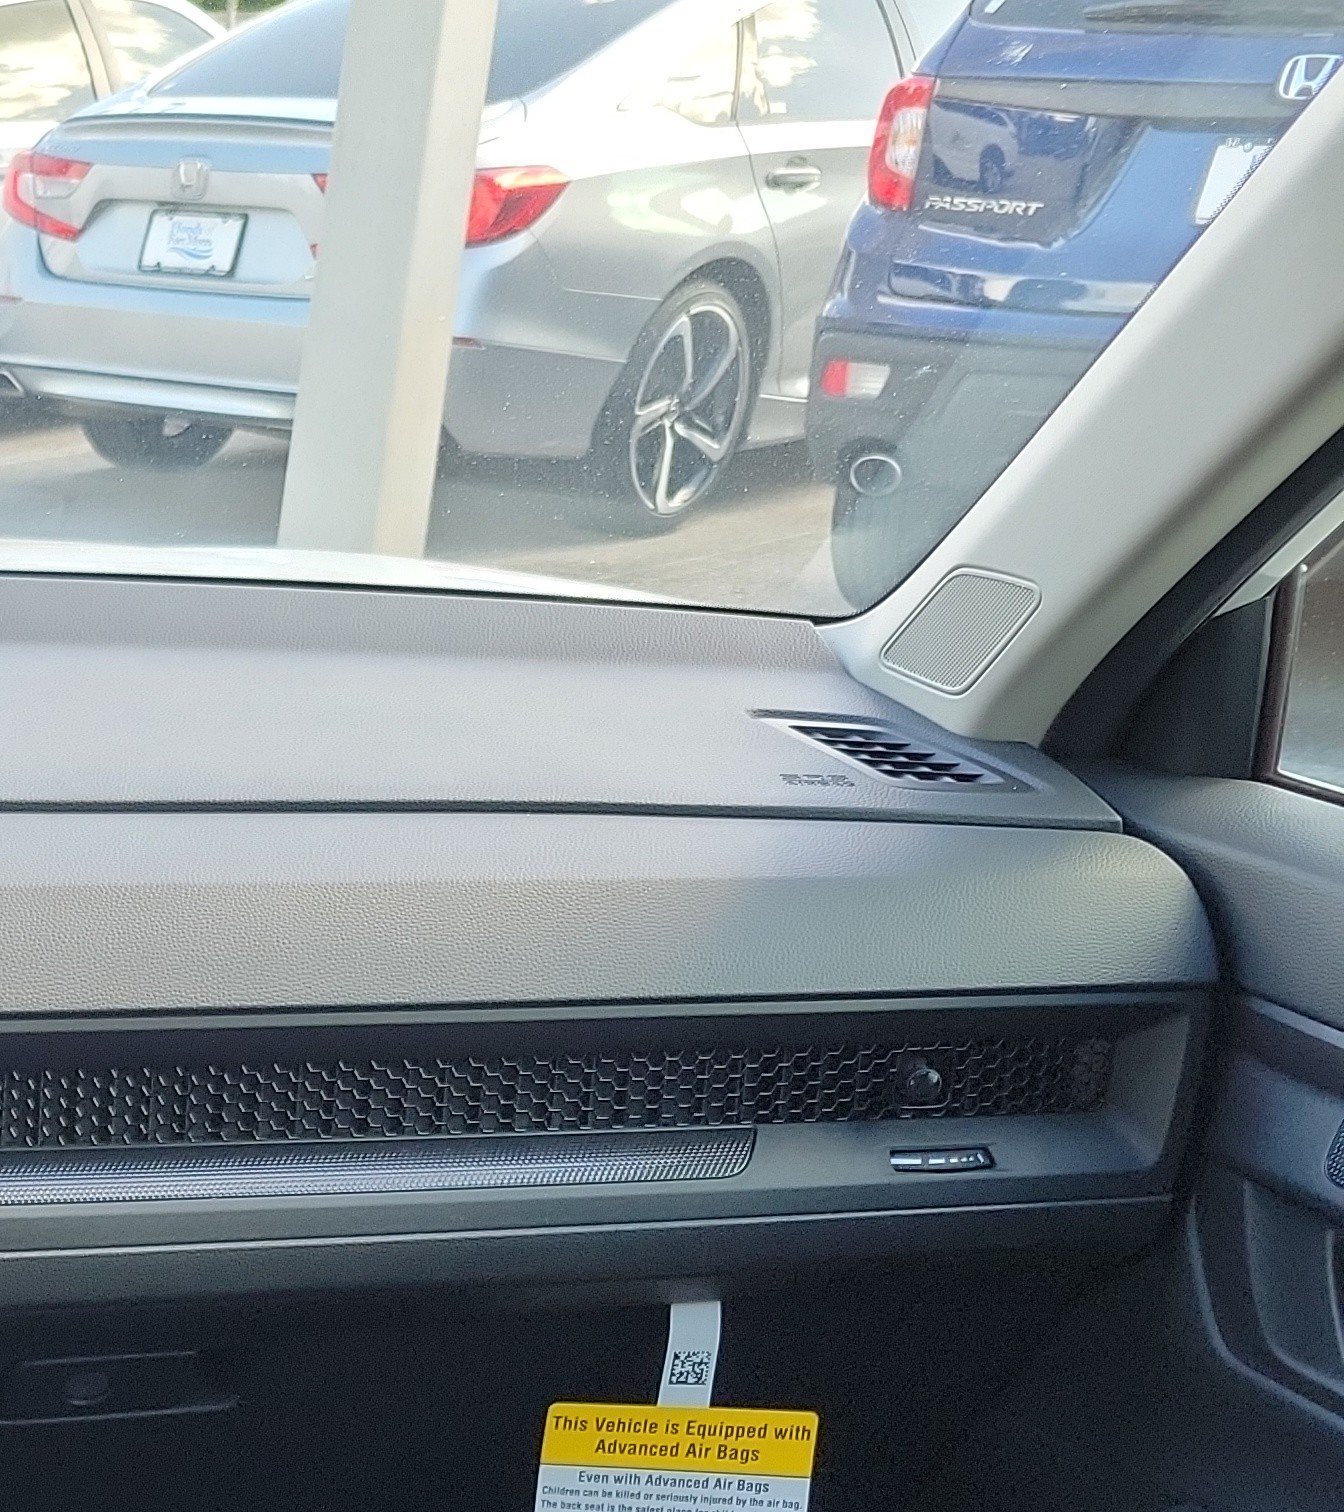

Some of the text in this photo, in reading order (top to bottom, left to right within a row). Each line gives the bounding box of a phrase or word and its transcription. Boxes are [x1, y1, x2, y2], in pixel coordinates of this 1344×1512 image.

[924, 196, 1045, 216] PASSPORT
[552, 1416, 811, 1441] This Vehicle is Equipped with
[595, 1439, 760, 1465] Advanced Air Bags
[578, 1470, 769, 1494] Even with Advanced Air Bags
[541, 1499, 557, 1509] The
[560, 1501, 582, 1510] back
[584, 1503, 605, 1512] seat
[607, 1503, 615, 1512] is
[618, 1503, 632, 1512] the
[542, 1485, 802, 1511] Children can be killed or seriously injured by the air bag.
